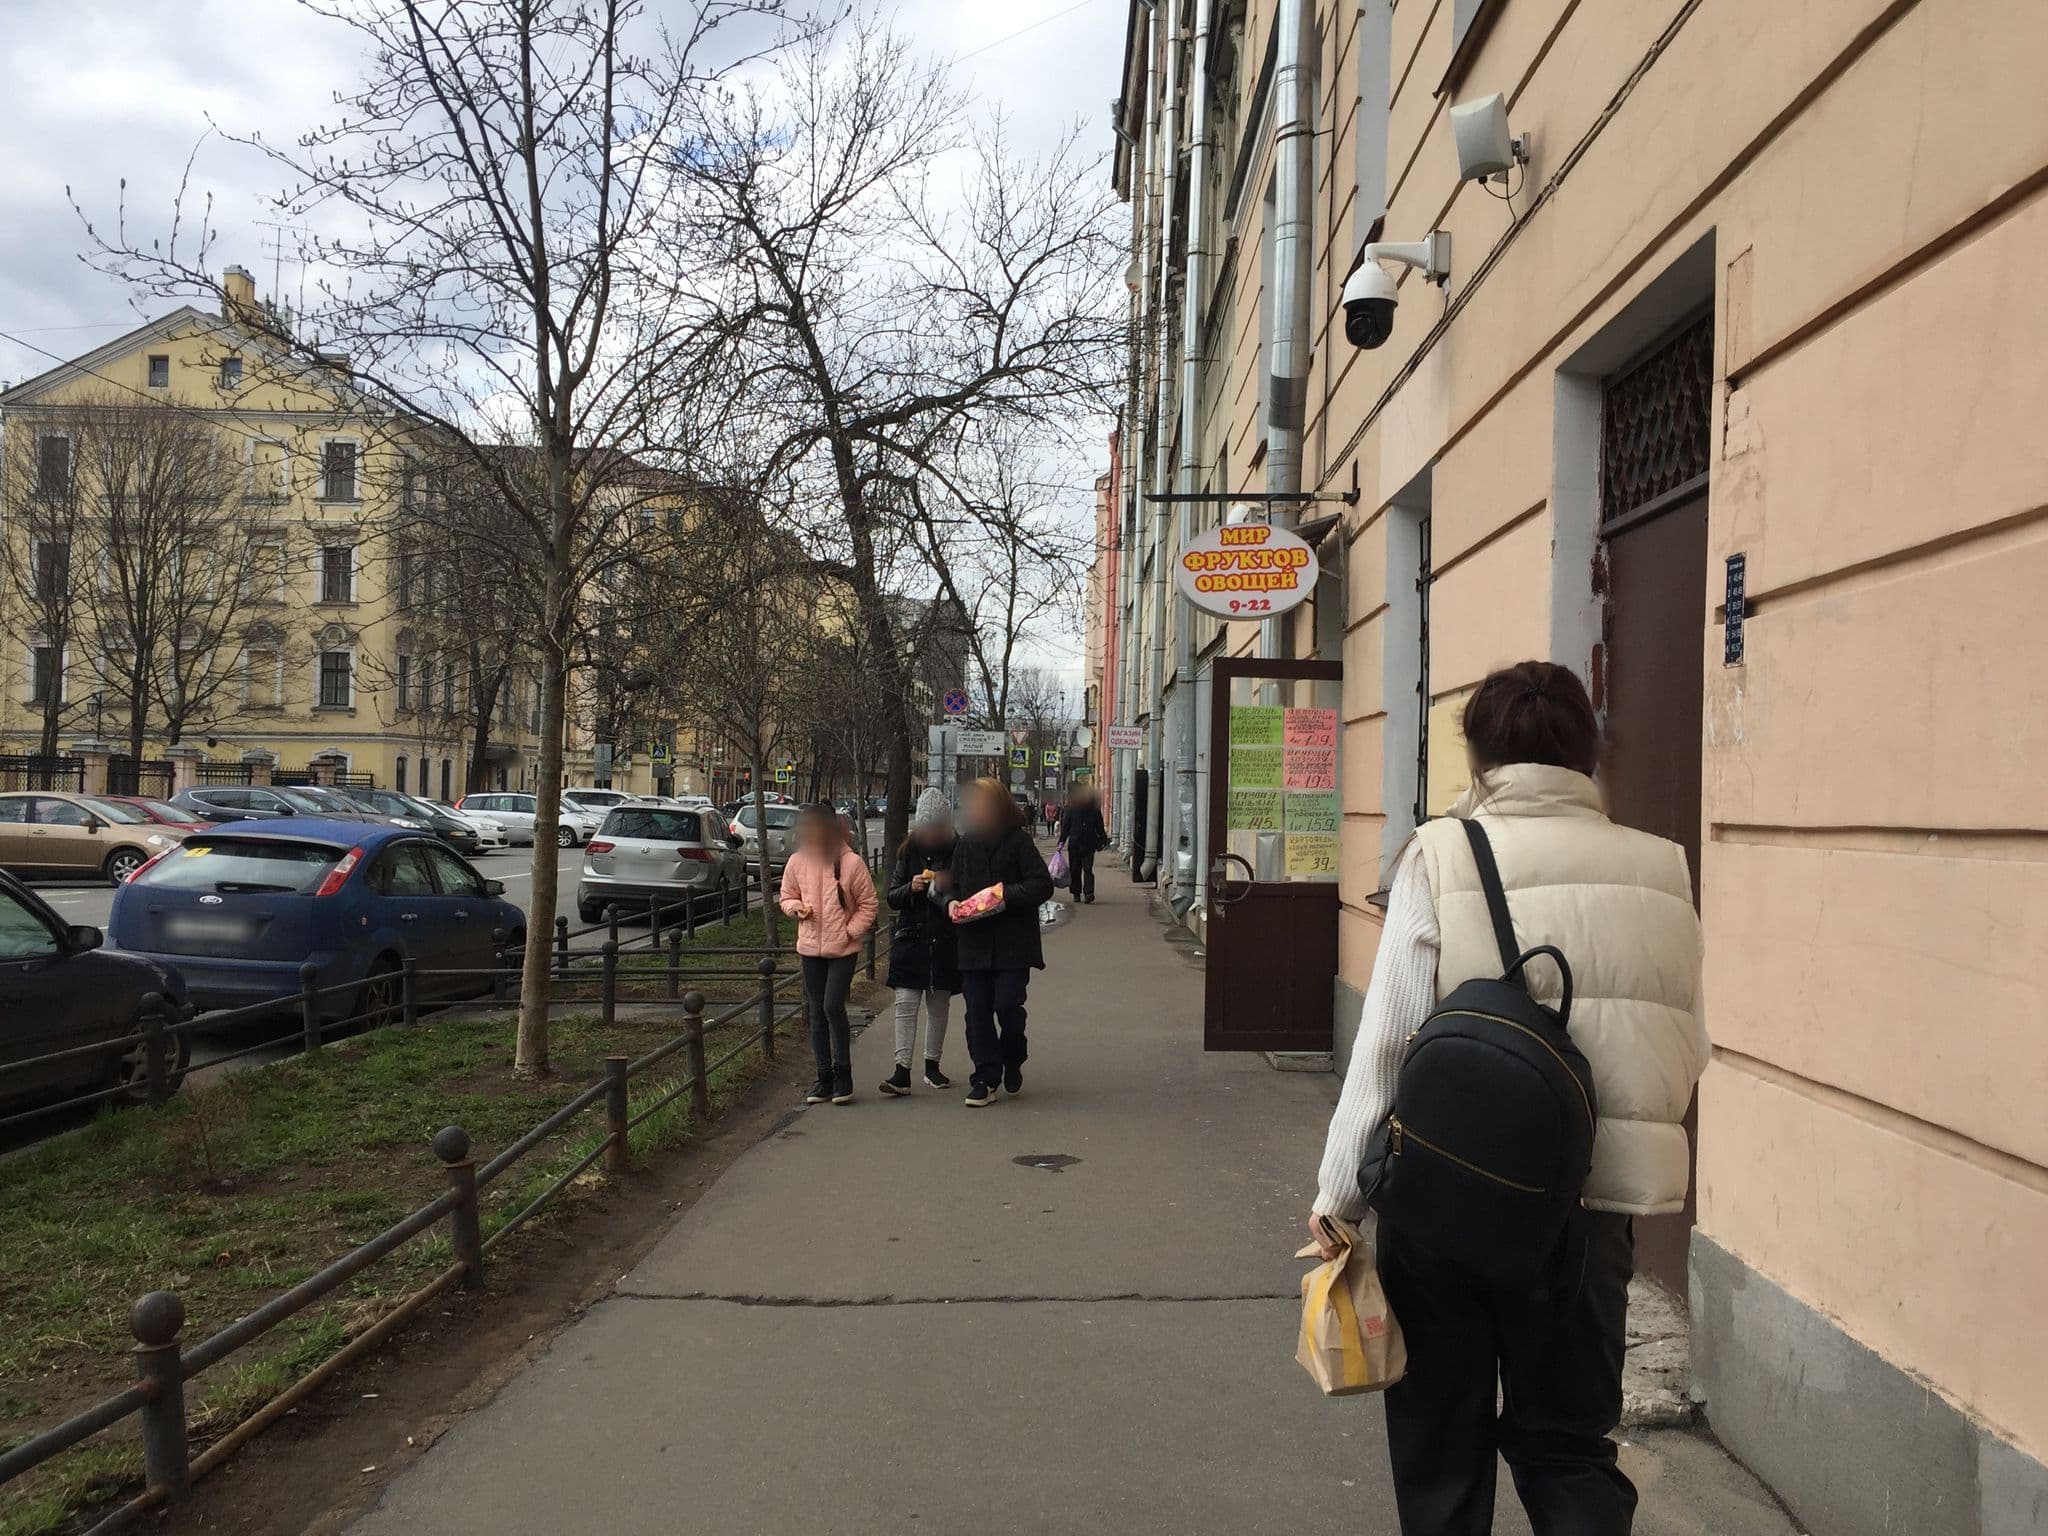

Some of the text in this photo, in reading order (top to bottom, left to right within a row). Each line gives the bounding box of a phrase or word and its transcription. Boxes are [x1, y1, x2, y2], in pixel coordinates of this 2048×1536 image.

[1220, 526, 1271, 546] МИР
[1183, 548, 1309, 572] ФРУКТОВ
[1195, 566, 1298, 593] ОВОЩЕЙ
[1229, 599, 1271, 613] 9-22
[1111, 729, 1141, 737] МАГАЗИН
[1110, 738, 1139, 746] ОДЕЖДЫ
